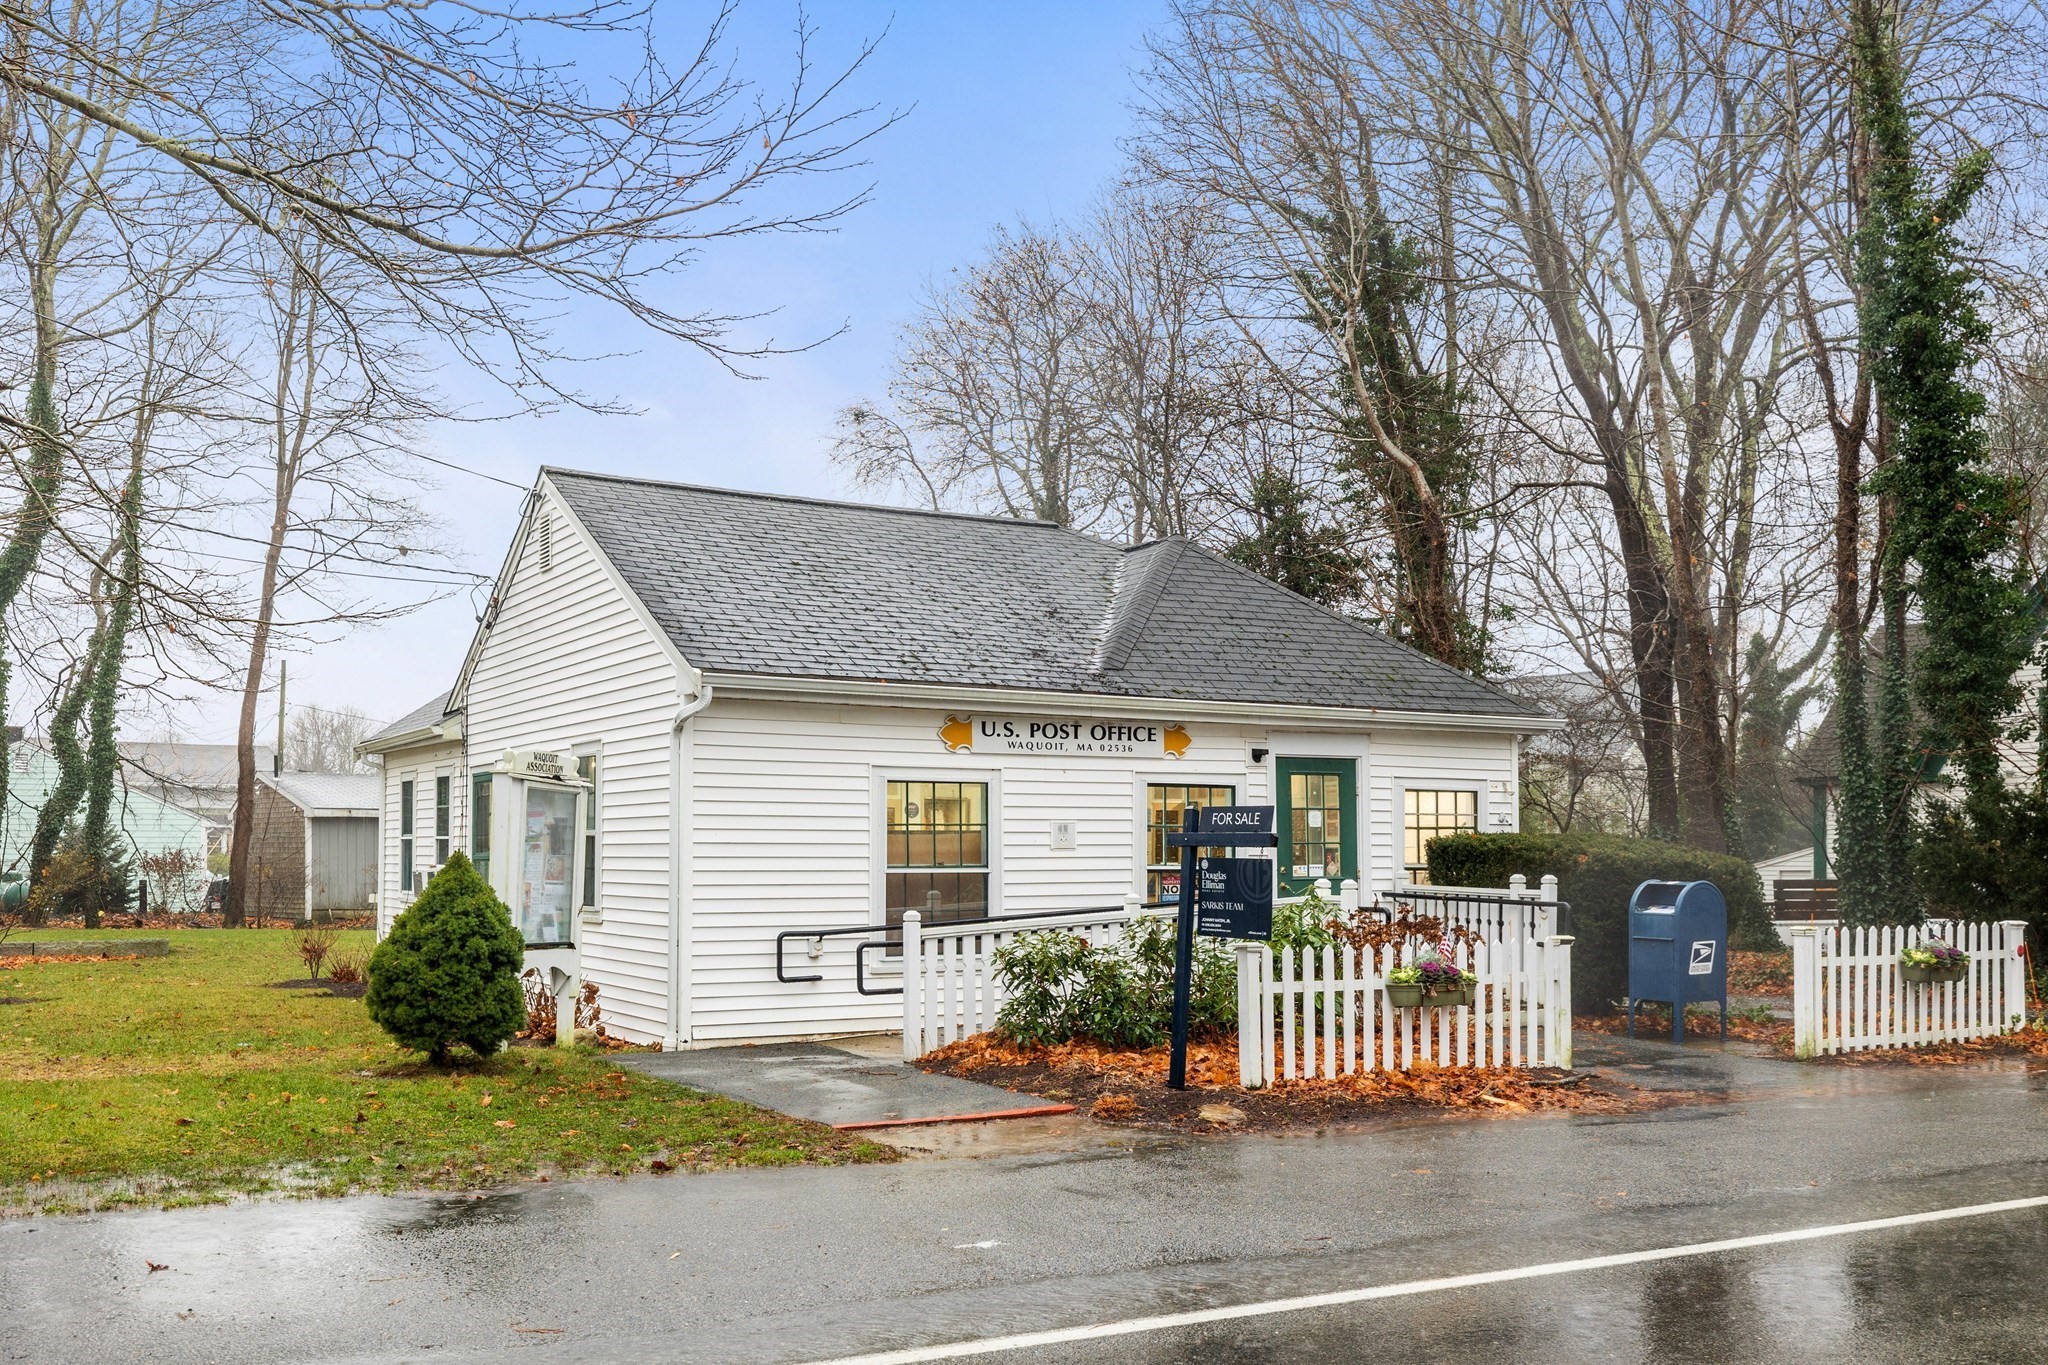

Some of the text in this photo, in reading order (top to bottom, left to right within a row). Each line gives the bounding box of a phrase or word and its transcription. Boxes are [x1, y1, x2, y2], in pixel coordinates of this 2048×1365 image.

[981, 721, 1157, 742] U.S. POST OFFICE
[1007, 741, 1133, 752] WAQUOIT, MA 02536
[533, 752, 559, 764] WAQUOIT
[526, 761, 564, 774] ASSOCIATION
[1211, 812, 1261, 825] FOR SALE
[1201, 870, 1227, 882] Douglas
[1162, 885, 1179, 894] NO
[1201, 880, 1225, 890] Elliman
[1201, 900, 1244, 911] SARKIS TEAM
